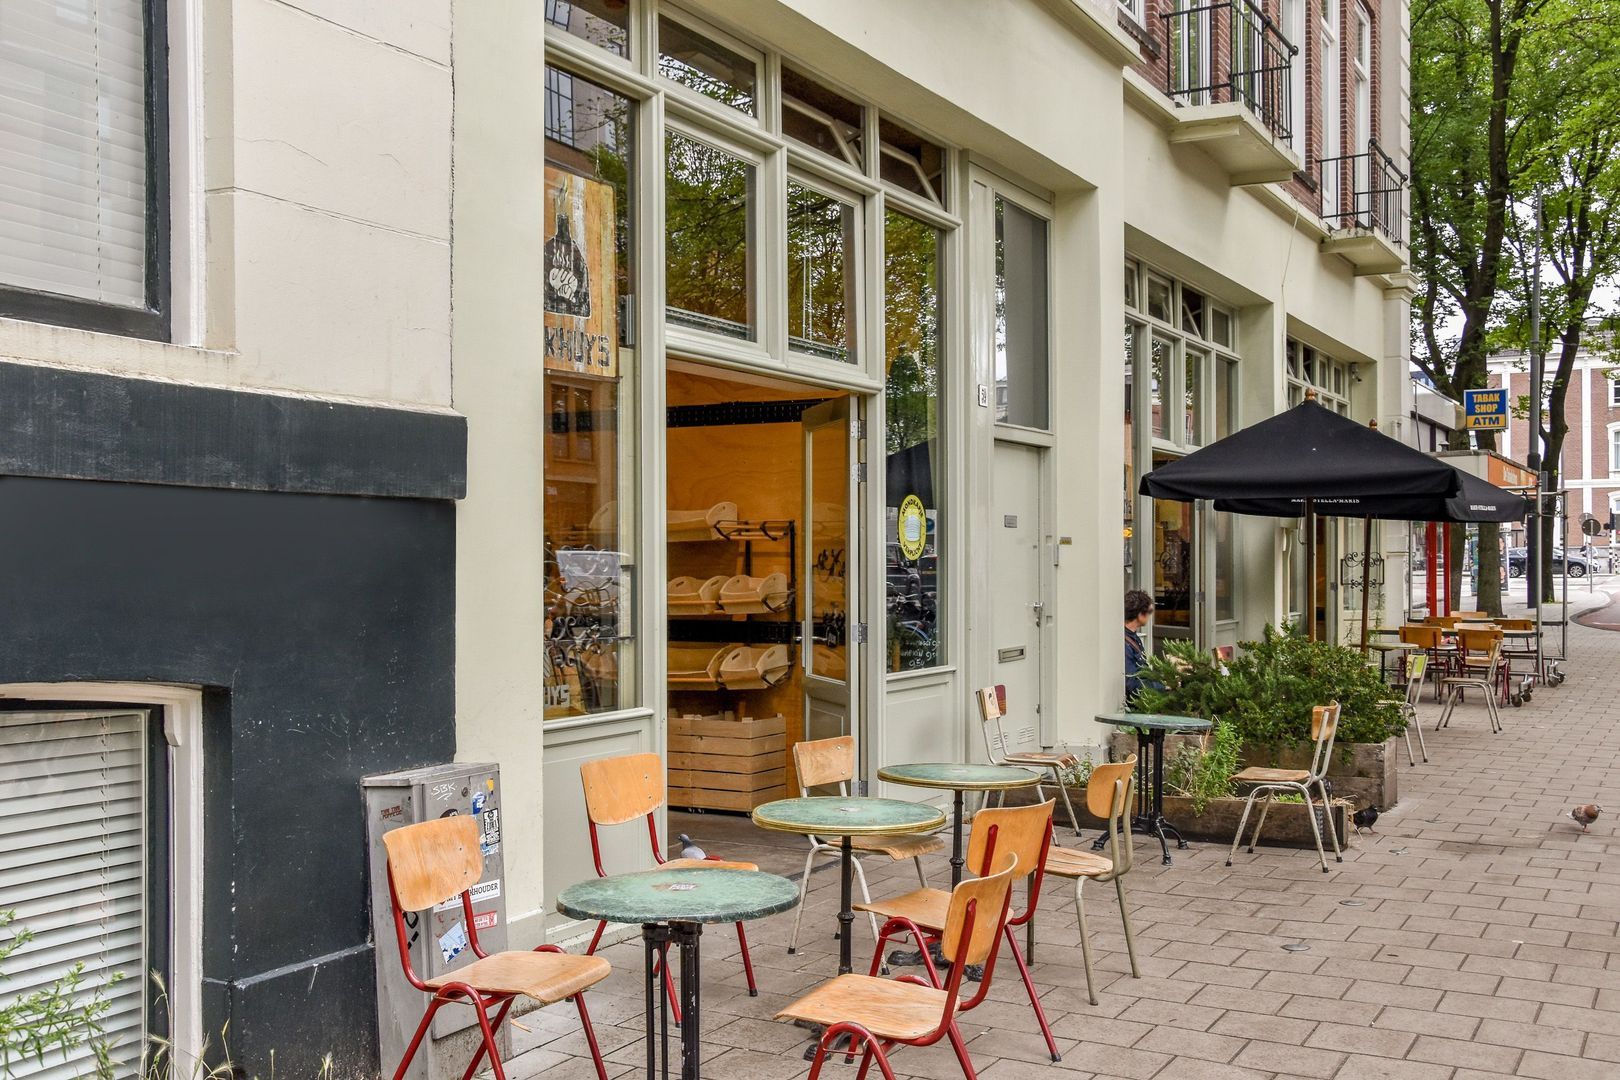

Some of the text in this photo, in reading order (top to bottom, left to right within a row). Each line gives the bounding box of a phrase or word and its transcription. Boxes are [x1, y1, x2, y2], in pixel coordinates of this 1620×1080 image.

[1472, 393, 1500, 403] TABAK
[1475, 403, 1498, 413] SHOP
[1473, 416, 1500, 426] ATM
